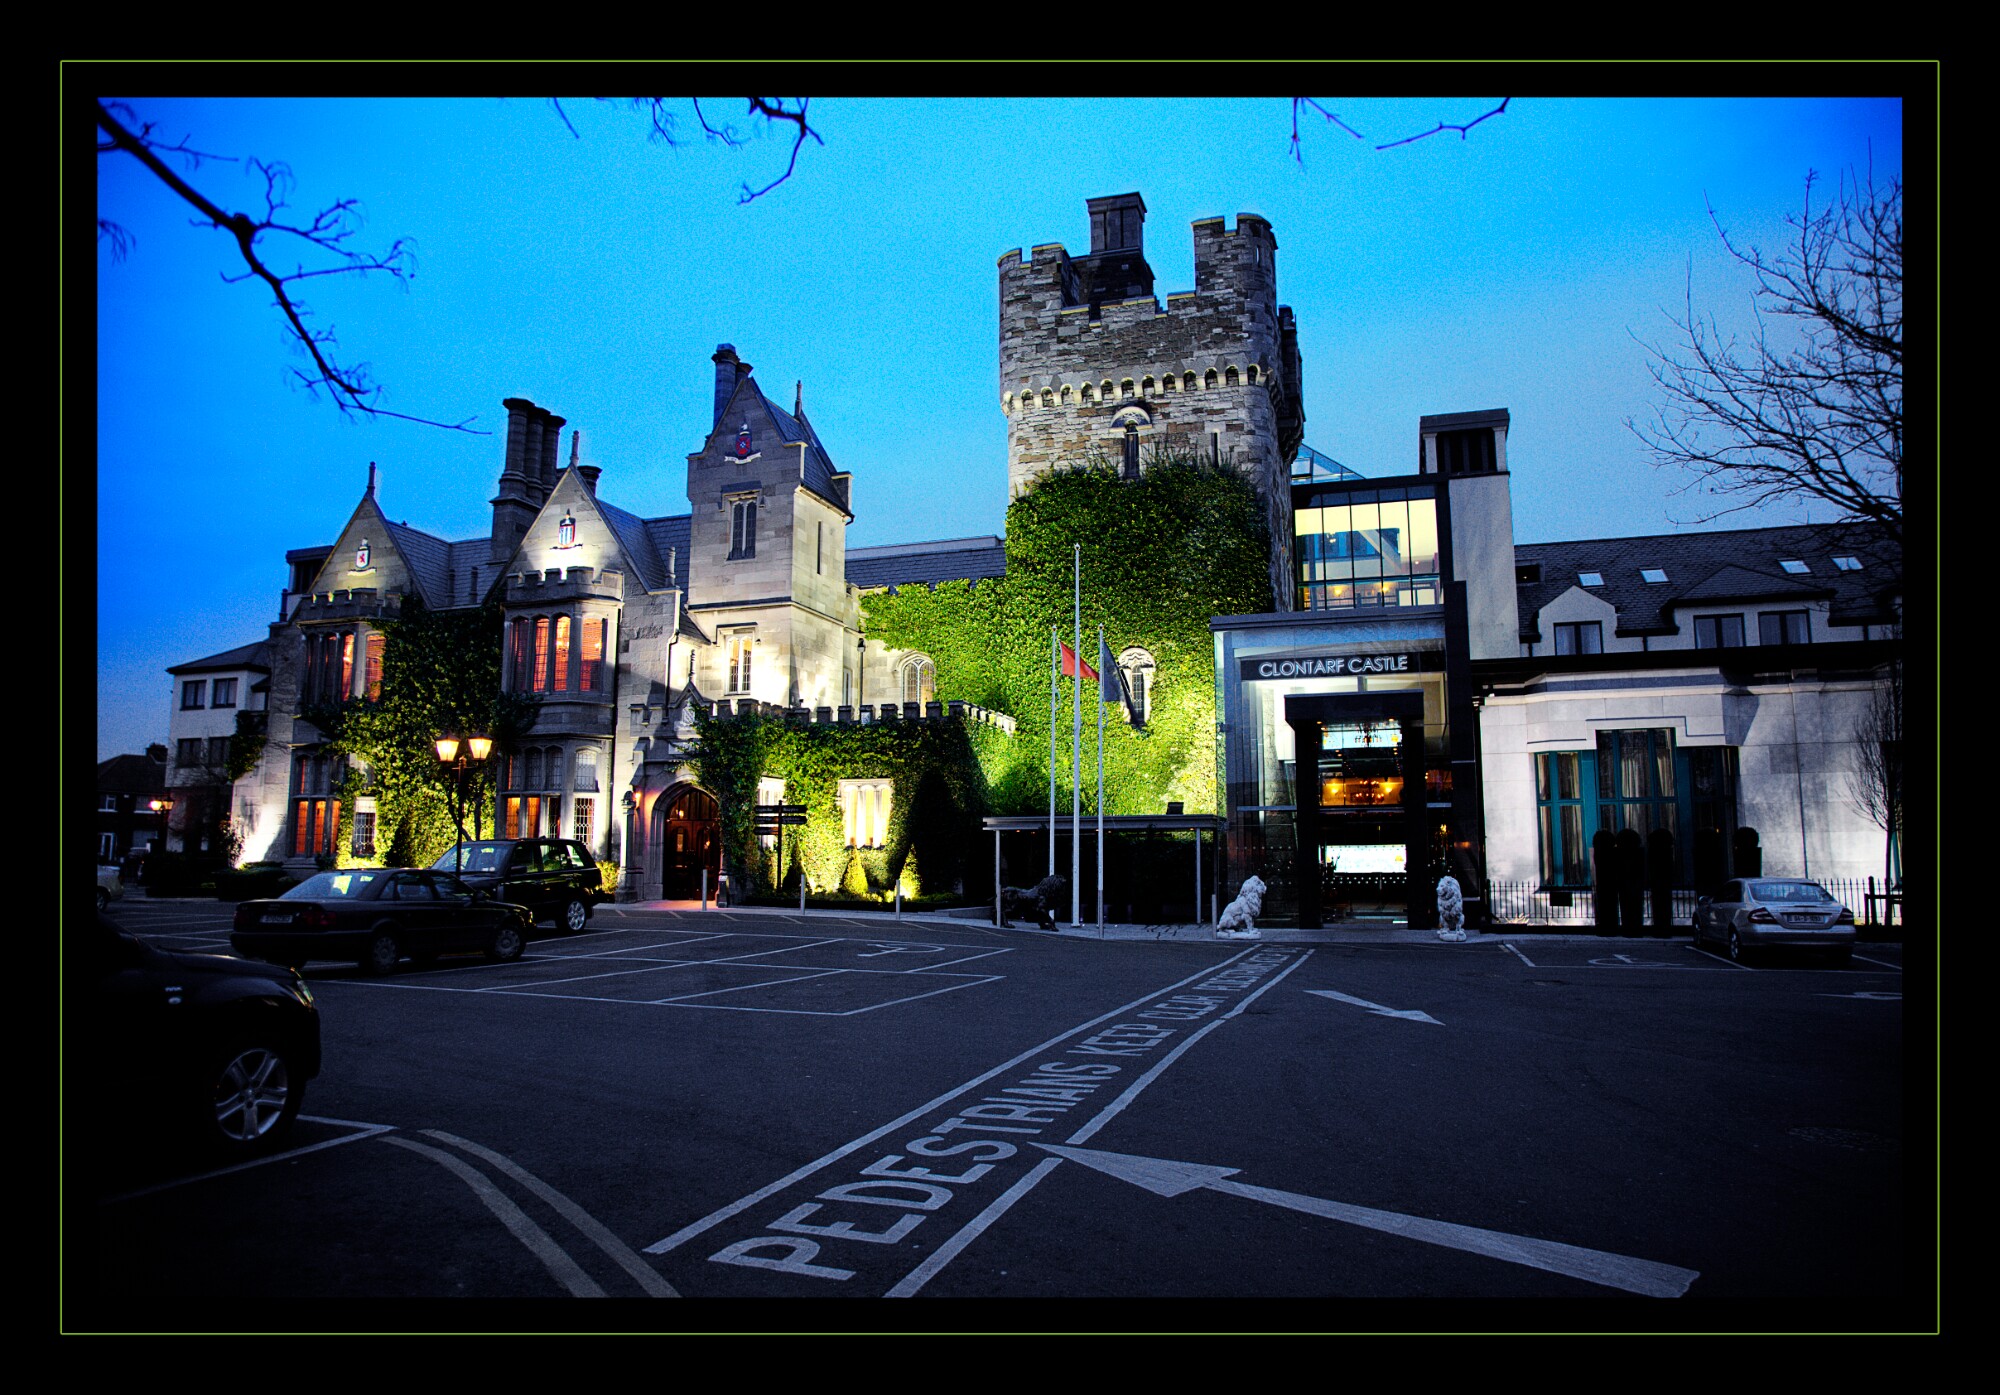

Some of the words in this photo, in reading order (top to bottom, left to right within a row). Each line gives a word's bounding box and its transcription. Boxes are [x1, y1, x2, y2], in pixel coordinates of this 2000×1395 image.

[1259, 659, 1345, 677] CLONTARF
[1347, 656, 1408, 673] CASTLE
[708, 1061, 1122, 1281] PEDESTRIANS
[1067, 1023, 1178, 1057] KEEP
[1137, 995, 1228, 1020] CLEAR
